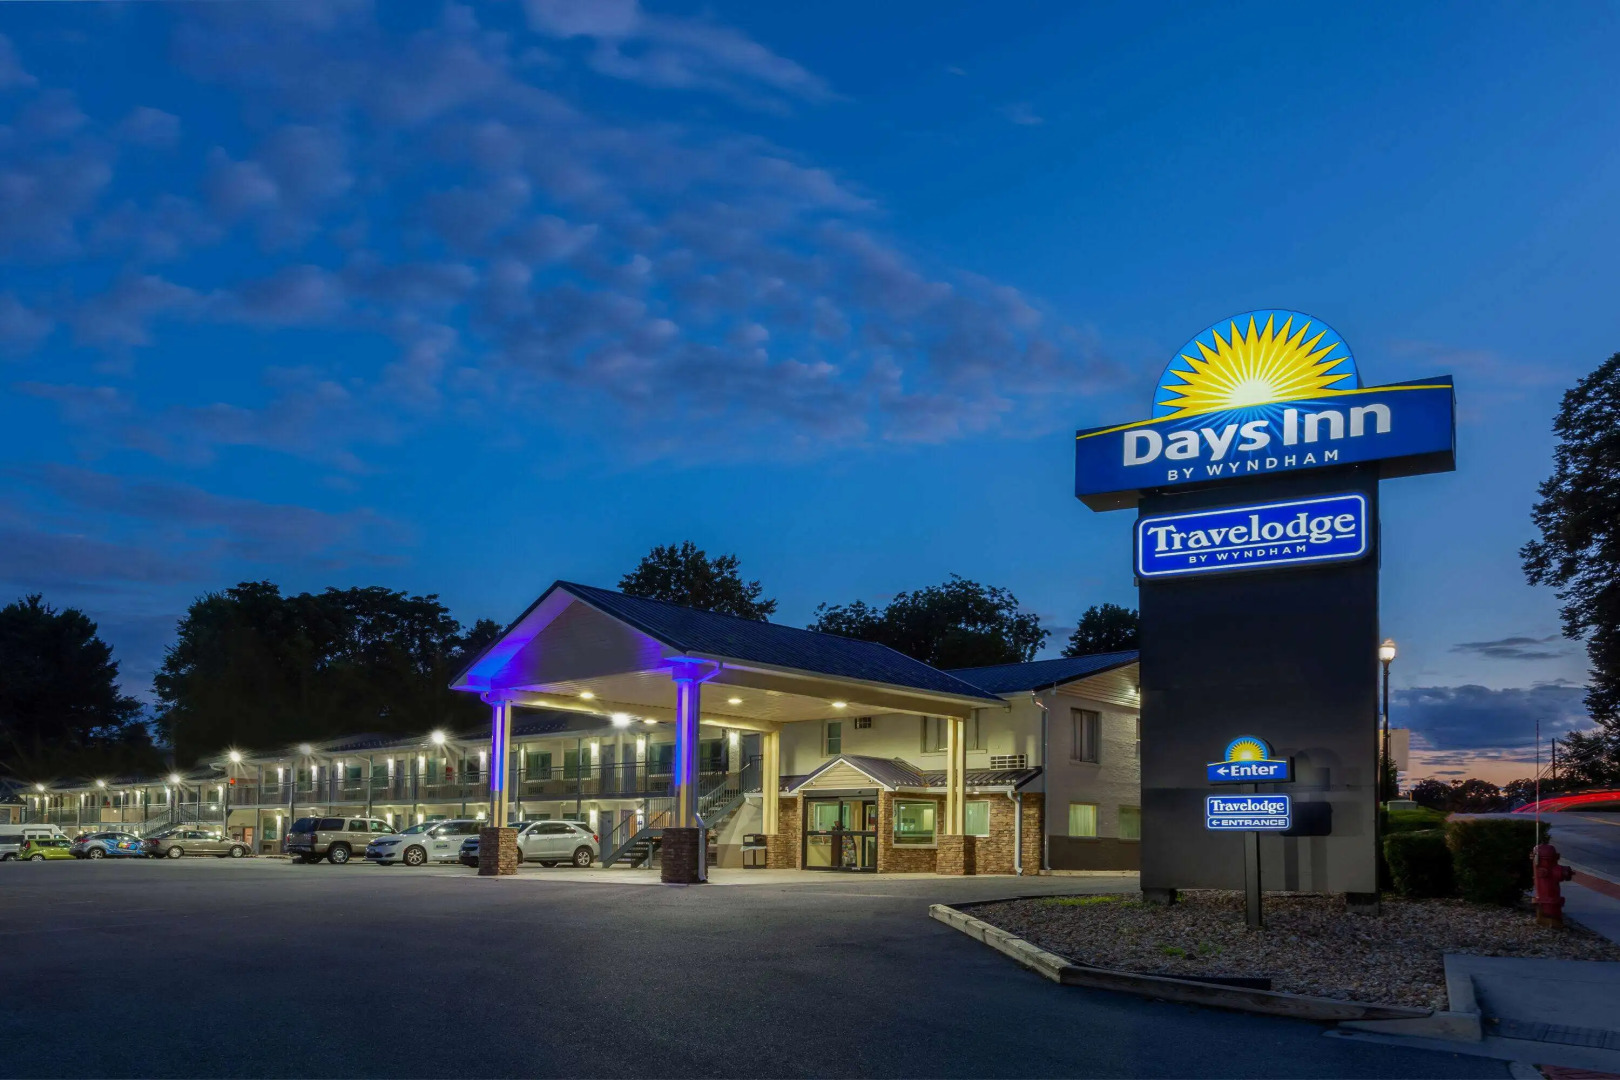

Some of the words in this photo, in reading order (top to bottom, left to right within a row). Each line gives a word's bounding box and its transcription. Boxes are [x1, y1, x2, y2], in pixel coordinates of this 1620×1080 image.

[1123, 420, 1270, 466] Days
[1283, 403, 1391, 446] Inn
[1167, 467, 1194, 481] BY
[1206, 449, 1340, 476] WYNDHAM
[1147, 511, 1355, 552] Travelodge
[1189, 554, 1208, 564] BY
[1216, 544, 1307, 561] WYNDHAM
[1230, 764, 1278, 777] Enter
[1210, 799, 1285, 814] Travelodge
